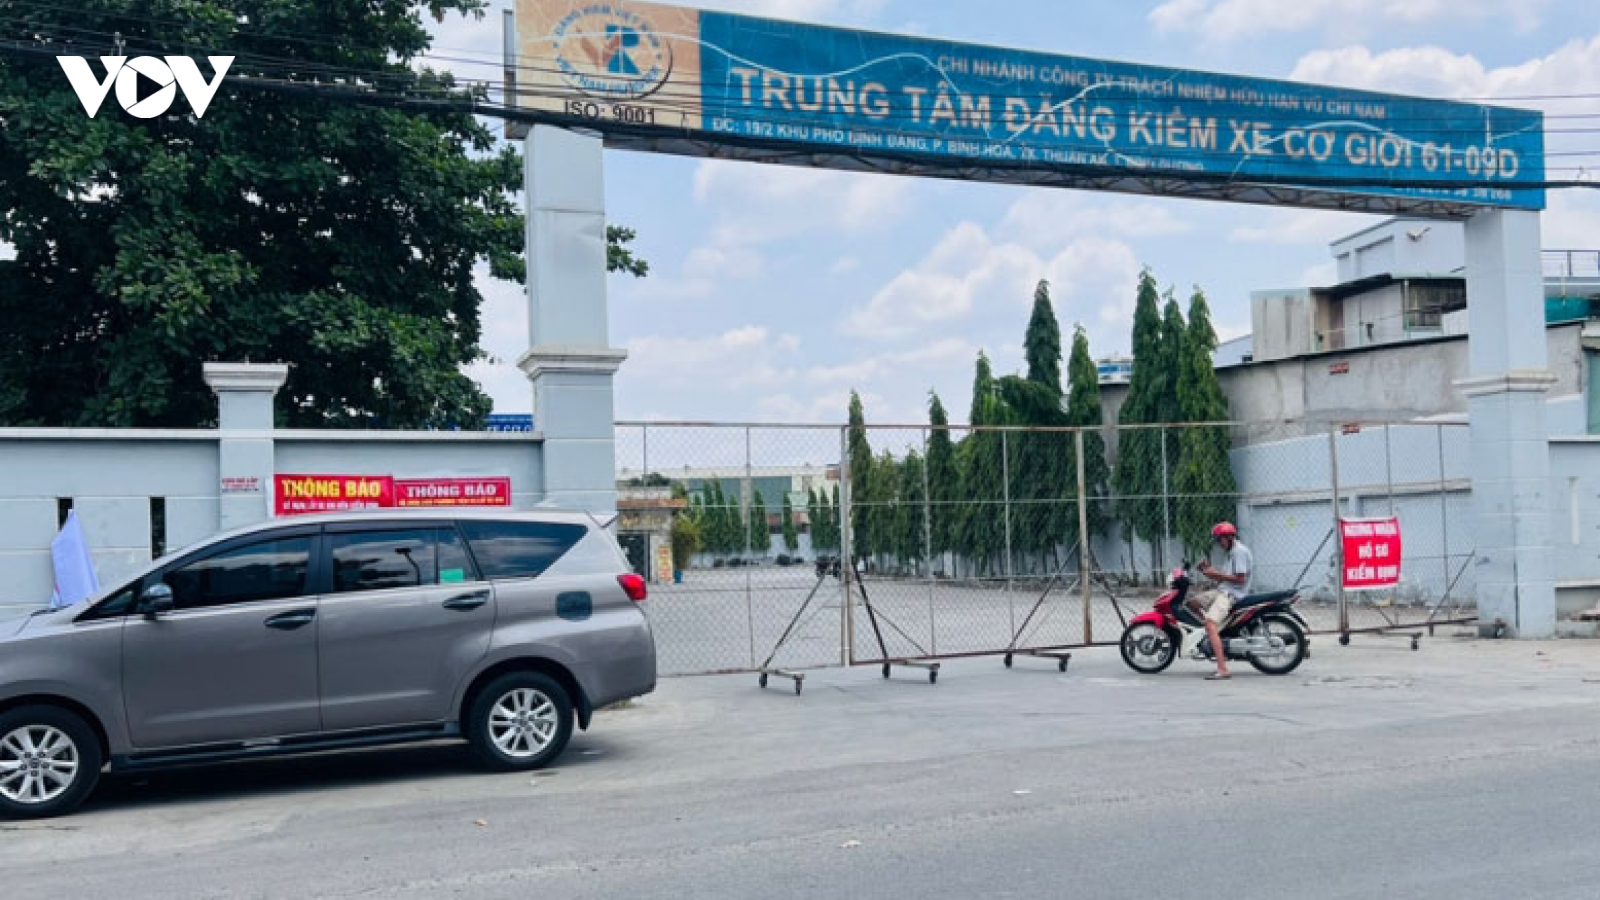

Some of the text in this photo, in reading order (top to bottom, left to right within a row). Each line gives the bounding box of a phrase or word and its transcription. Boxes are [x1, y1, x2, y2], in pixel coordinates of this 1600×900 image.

[1040, 65, 1089, 87] CÔNG
[564, 100, 655, 126] ISO: 9001
[731, 67, 890, 119] TRUNG
[902, 80, 990, 129] TÂM
[1003, 92, 1117, 142] ĐĂNG
[1229, 118, 1274, 156] XE
[1283, 126, 1336, 162] CƠ
[1421, 140, 1519, 179] 61-09D
[776, 122, 809, 139] KHU
[281, 476, 382, 499] THÔNG BÁO
[406, 482, 498, 498] THÔNG BÁO
